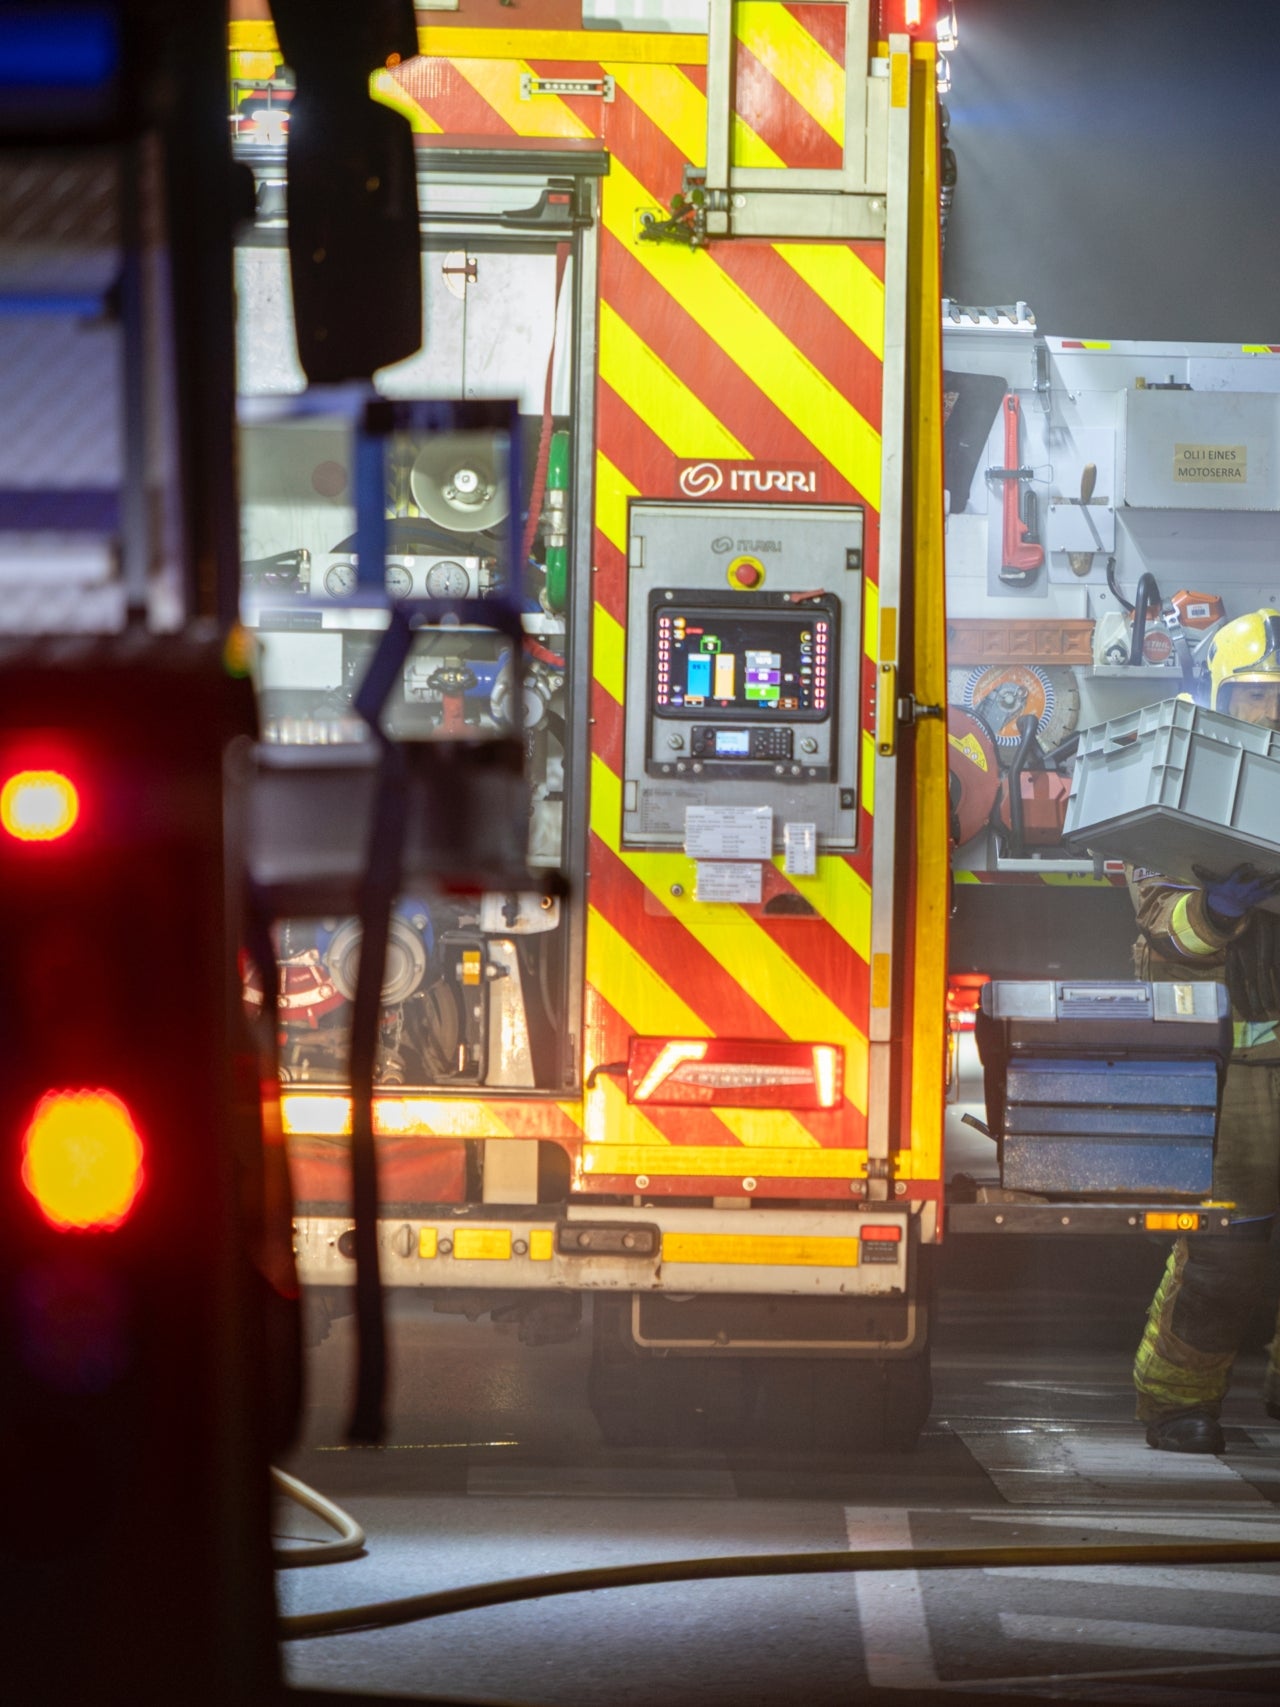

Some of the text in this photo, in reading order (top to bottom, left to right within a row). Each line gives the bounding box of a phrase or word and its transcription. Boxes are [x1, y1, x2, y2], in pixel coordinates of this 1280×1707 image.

[1183, 449, 1200, 460] OLI
[1208, 450, 1237, 461] EINES
[1178, 467, 1242, 477] MOTOSERRA
[731, 470, 816, 493] ITURRI
[737, 539, 782, 553] ITURRI
